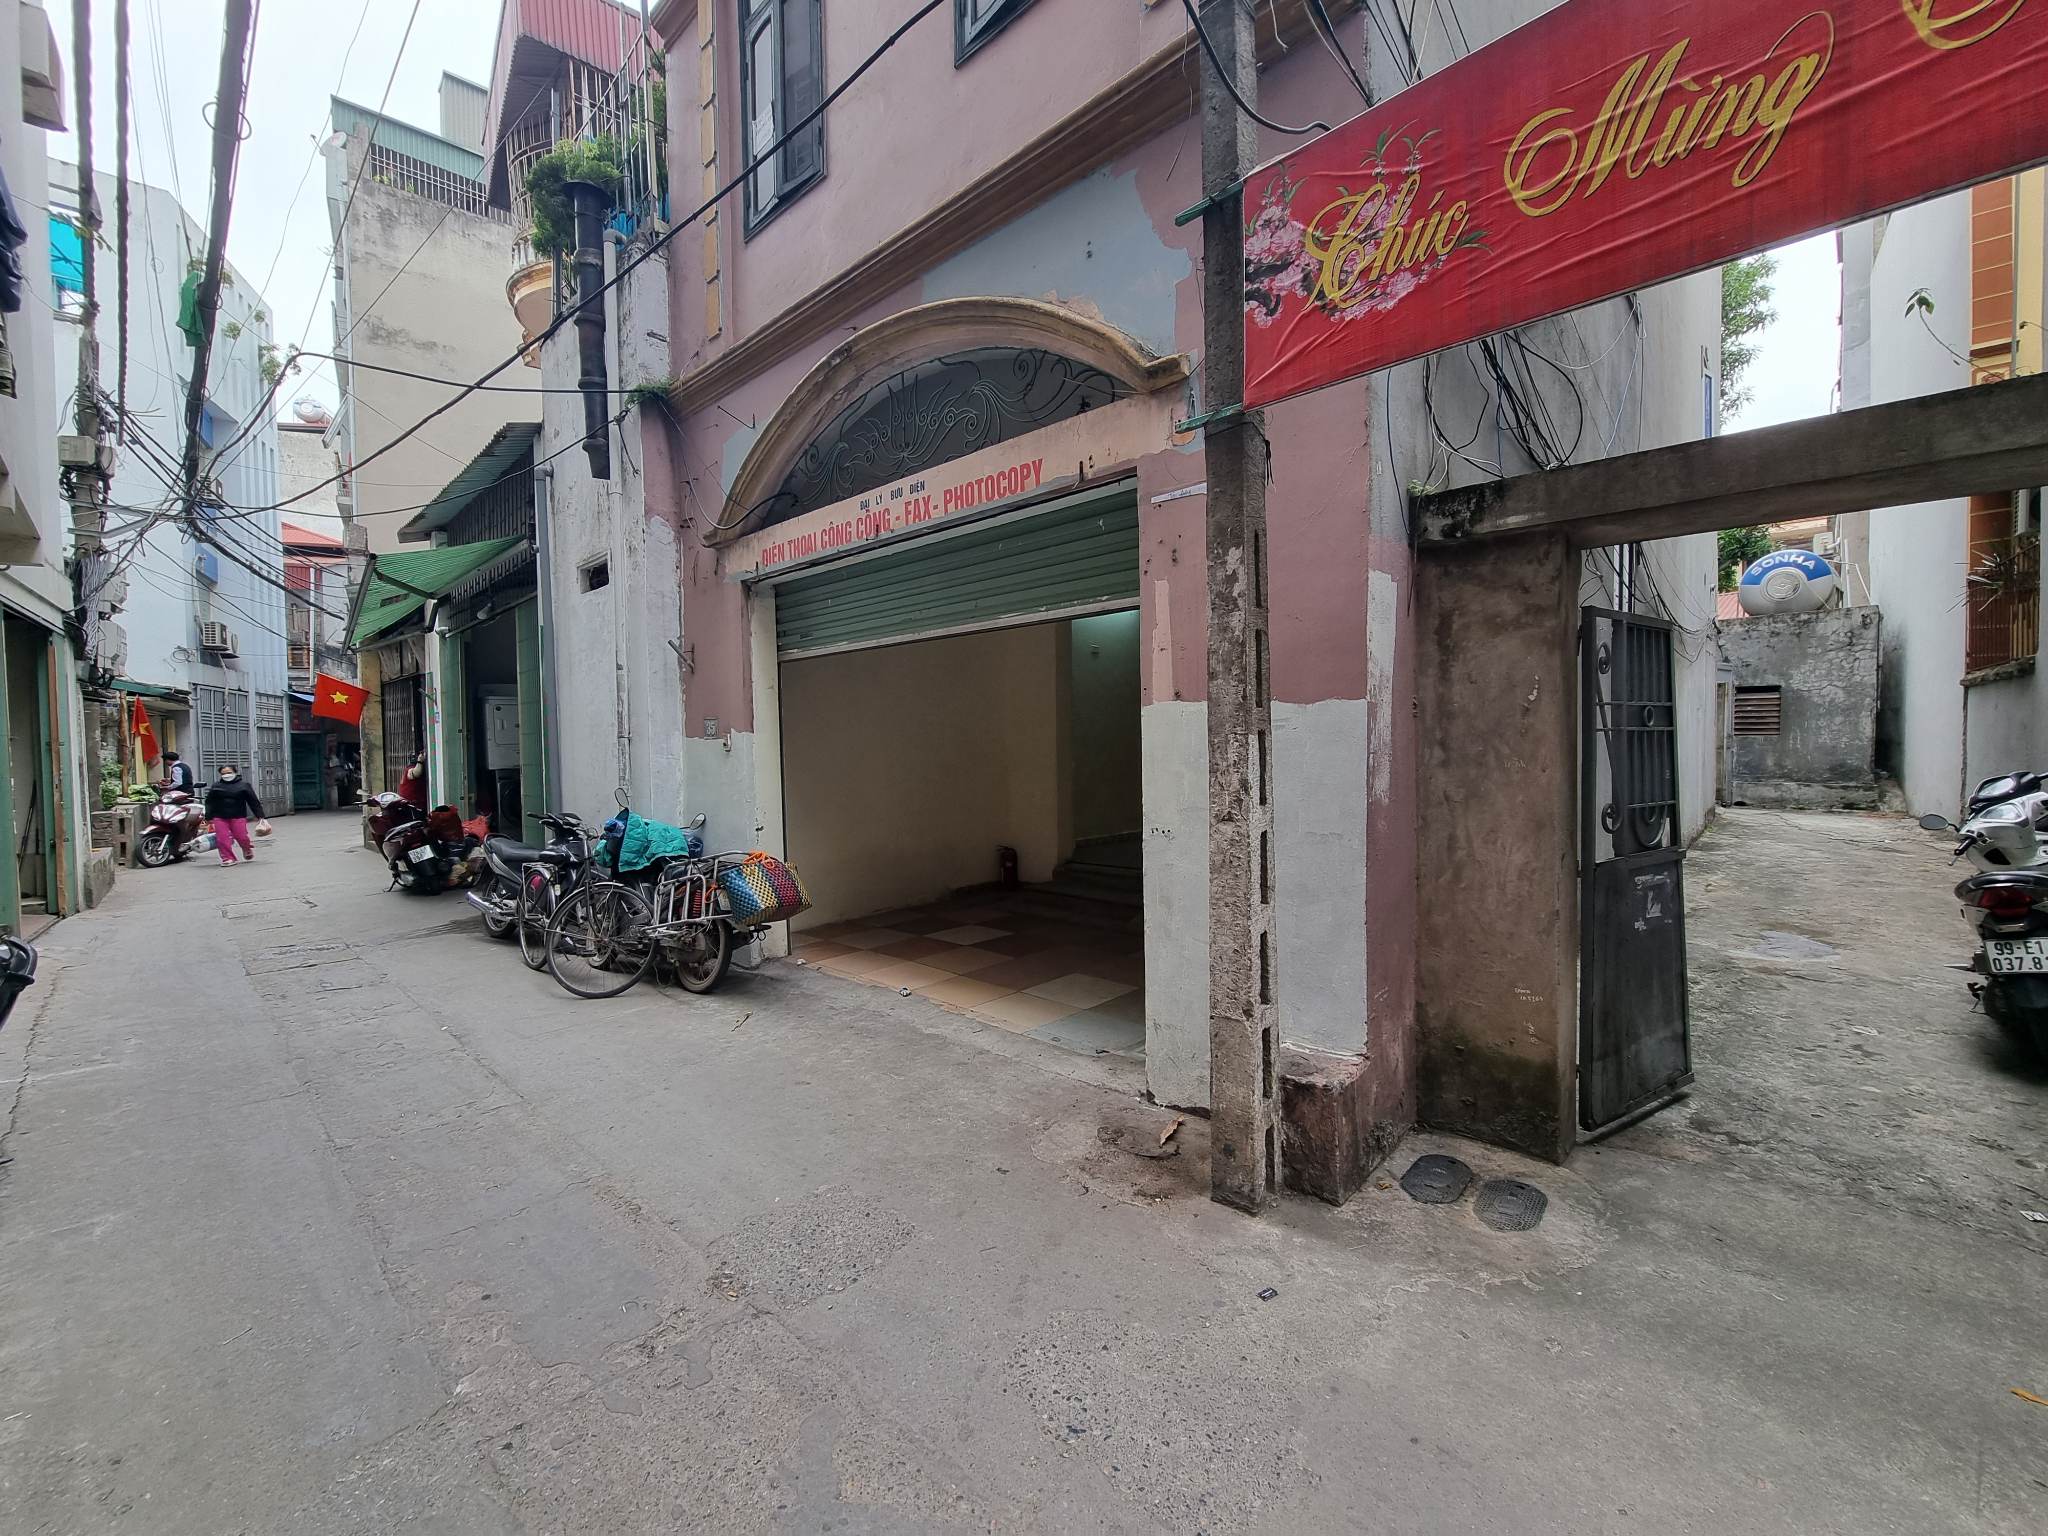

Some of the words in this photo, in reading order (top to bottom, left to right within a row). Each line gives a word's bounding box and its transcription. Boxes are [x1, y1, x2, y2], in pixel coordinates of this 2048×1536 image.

[1302, 172, 1470, 311] Chúc
[1503, 11, 1835, 217] Mừng
[820, 521, 852, 550] CÔNG
[904, 495, 932, 526] FAX
[943, 458, 1043, 516] PHOTOCOPY
[1750, 553, 1816, 576] SONHA
[1993, 940, 2044, 956] 99-E1
[1991, 956, 2048, 972] 037.8
